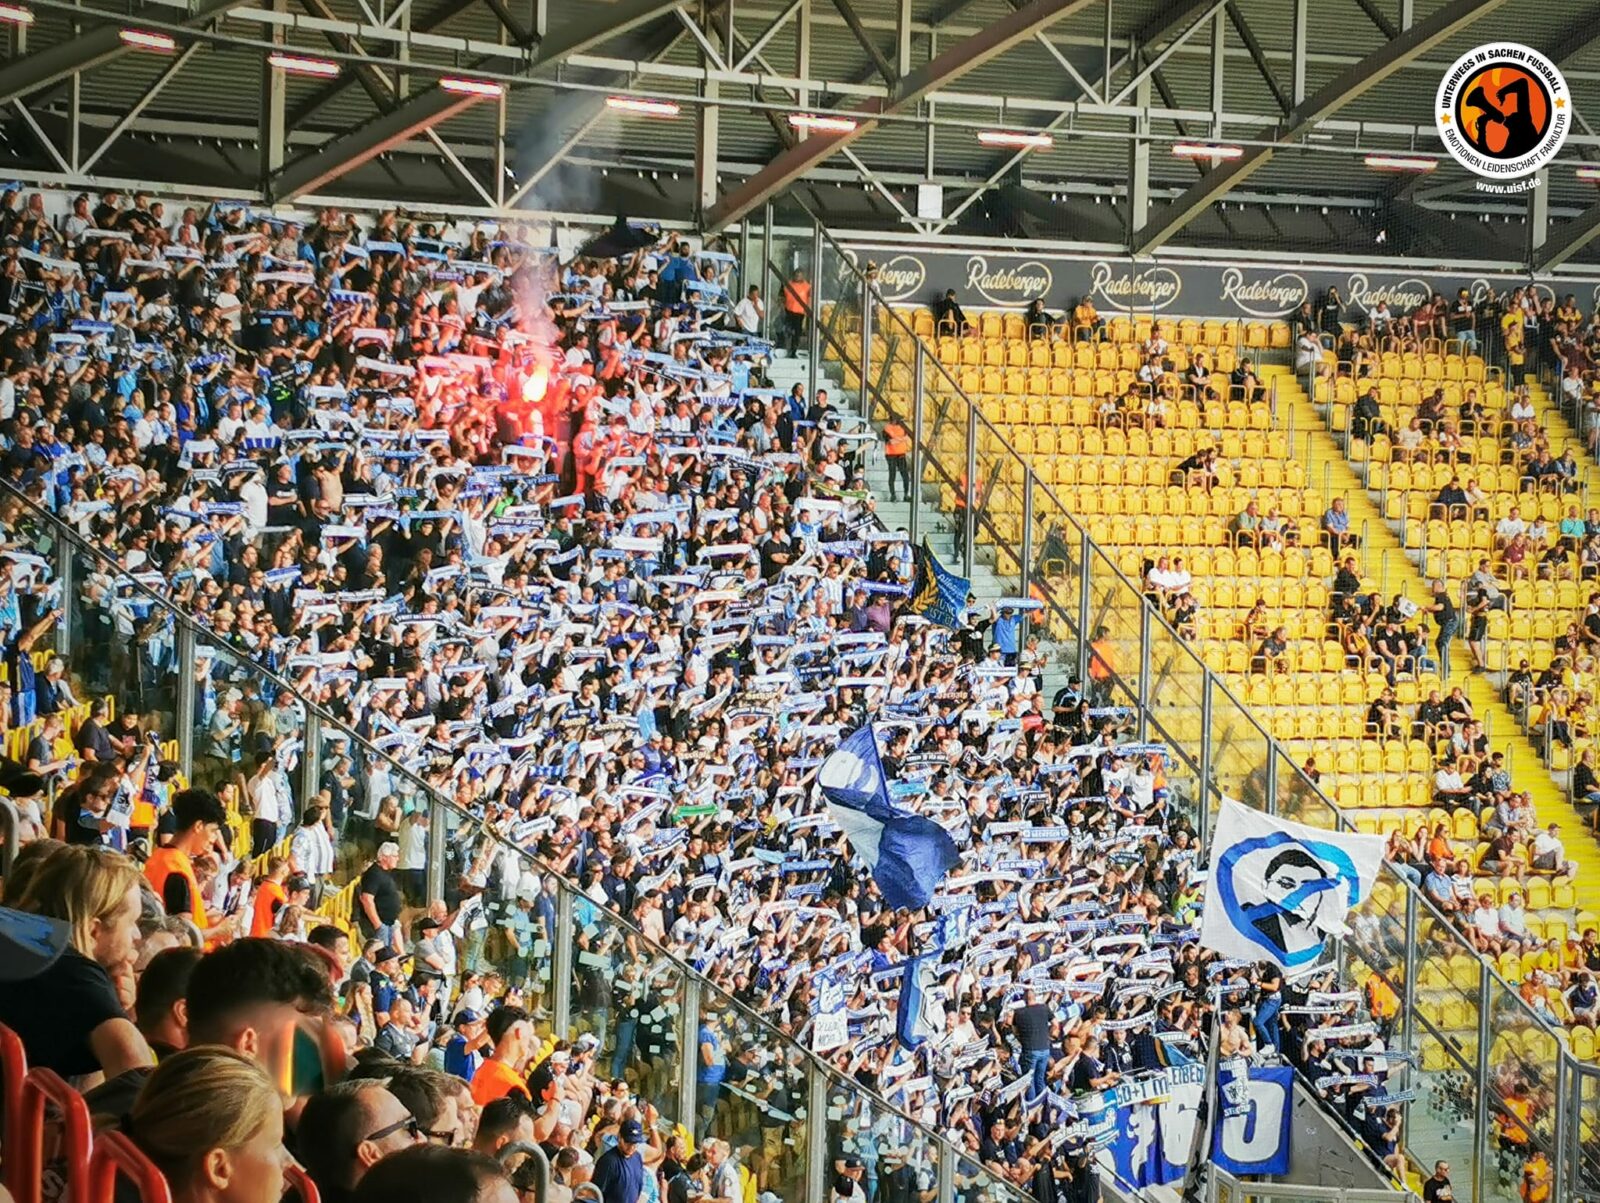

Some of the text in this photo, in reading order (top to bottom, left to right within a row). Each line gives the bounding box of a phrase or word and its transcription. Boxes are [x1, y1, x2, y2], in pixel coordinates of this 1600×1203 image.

[964, 255, 1047, 300] Radeberger
[1089, 262, 1176, 302] Radeberger
[1220, 267, 1303, 307] Radeberger
[1346, 273, 1426, 312] Radeberger
